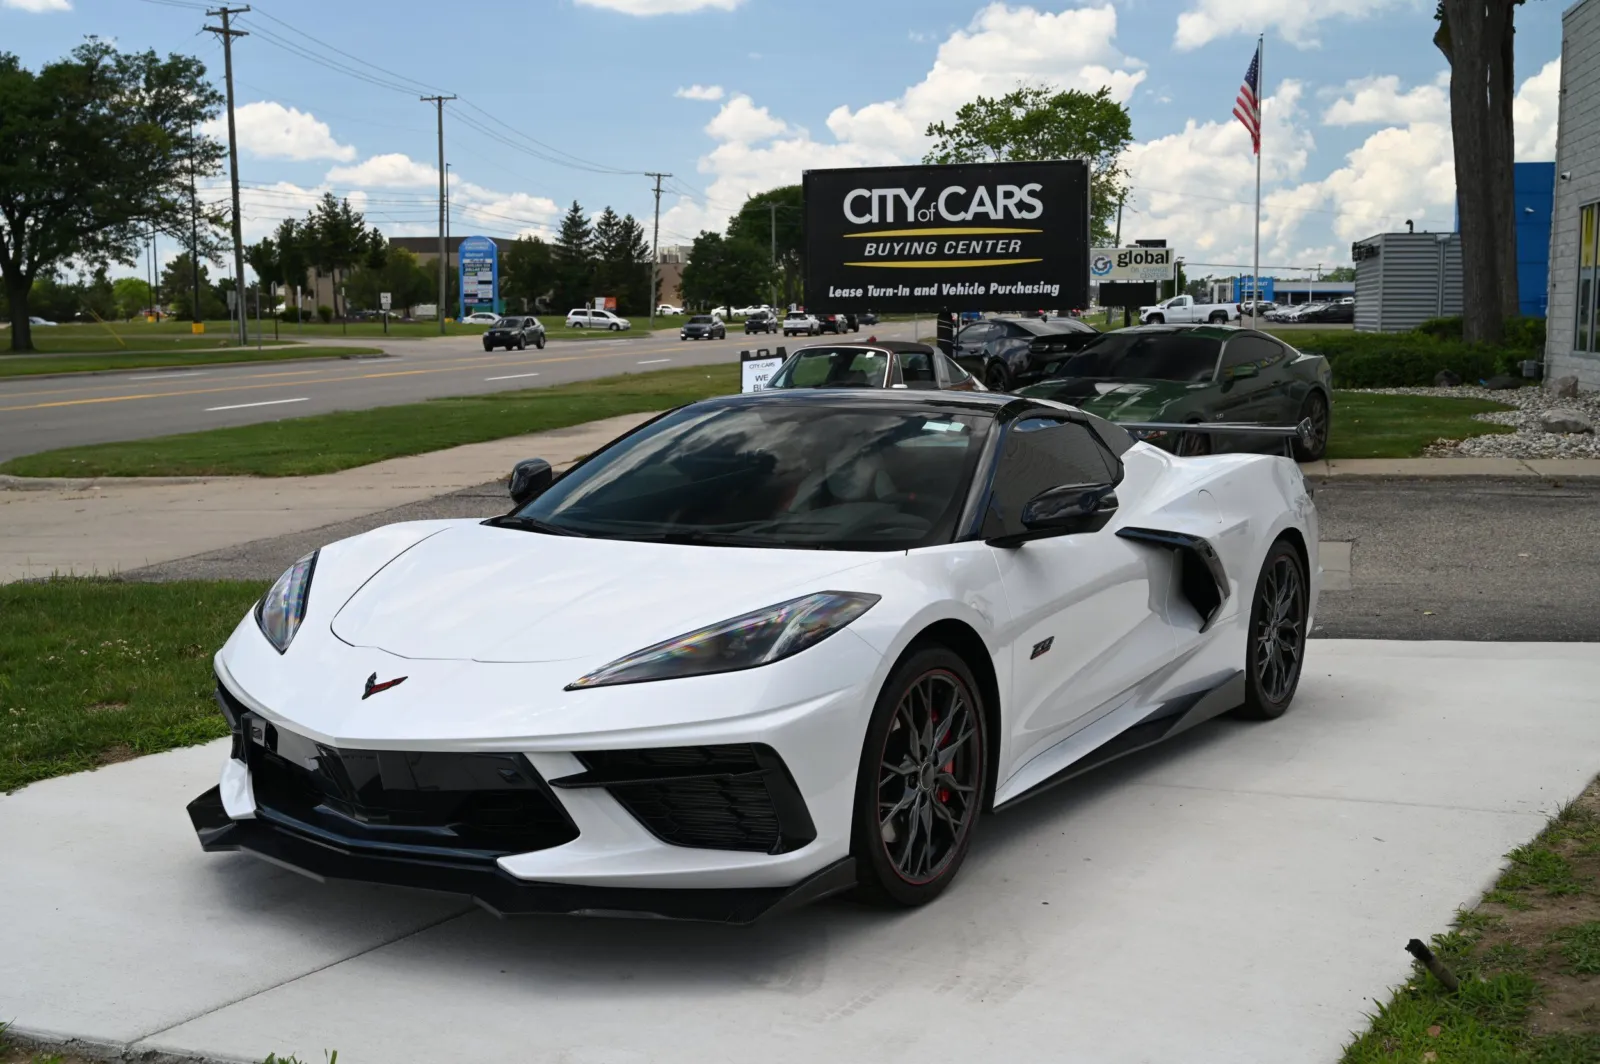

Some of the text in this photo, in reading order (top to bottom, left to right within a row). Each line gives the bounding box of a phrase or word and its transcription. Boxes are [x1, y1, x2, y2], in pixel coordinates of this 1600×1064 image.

[843, 183, 1044, 224] CITY of CARS
[864, 239, 1022, 256] BUYING CENTER
[1117, 250, 1169, 268] global
[828, 281, 1060, 298] Lease Turn-In and Vehicle Purchasing
[755, 374, 768, 382] WE
